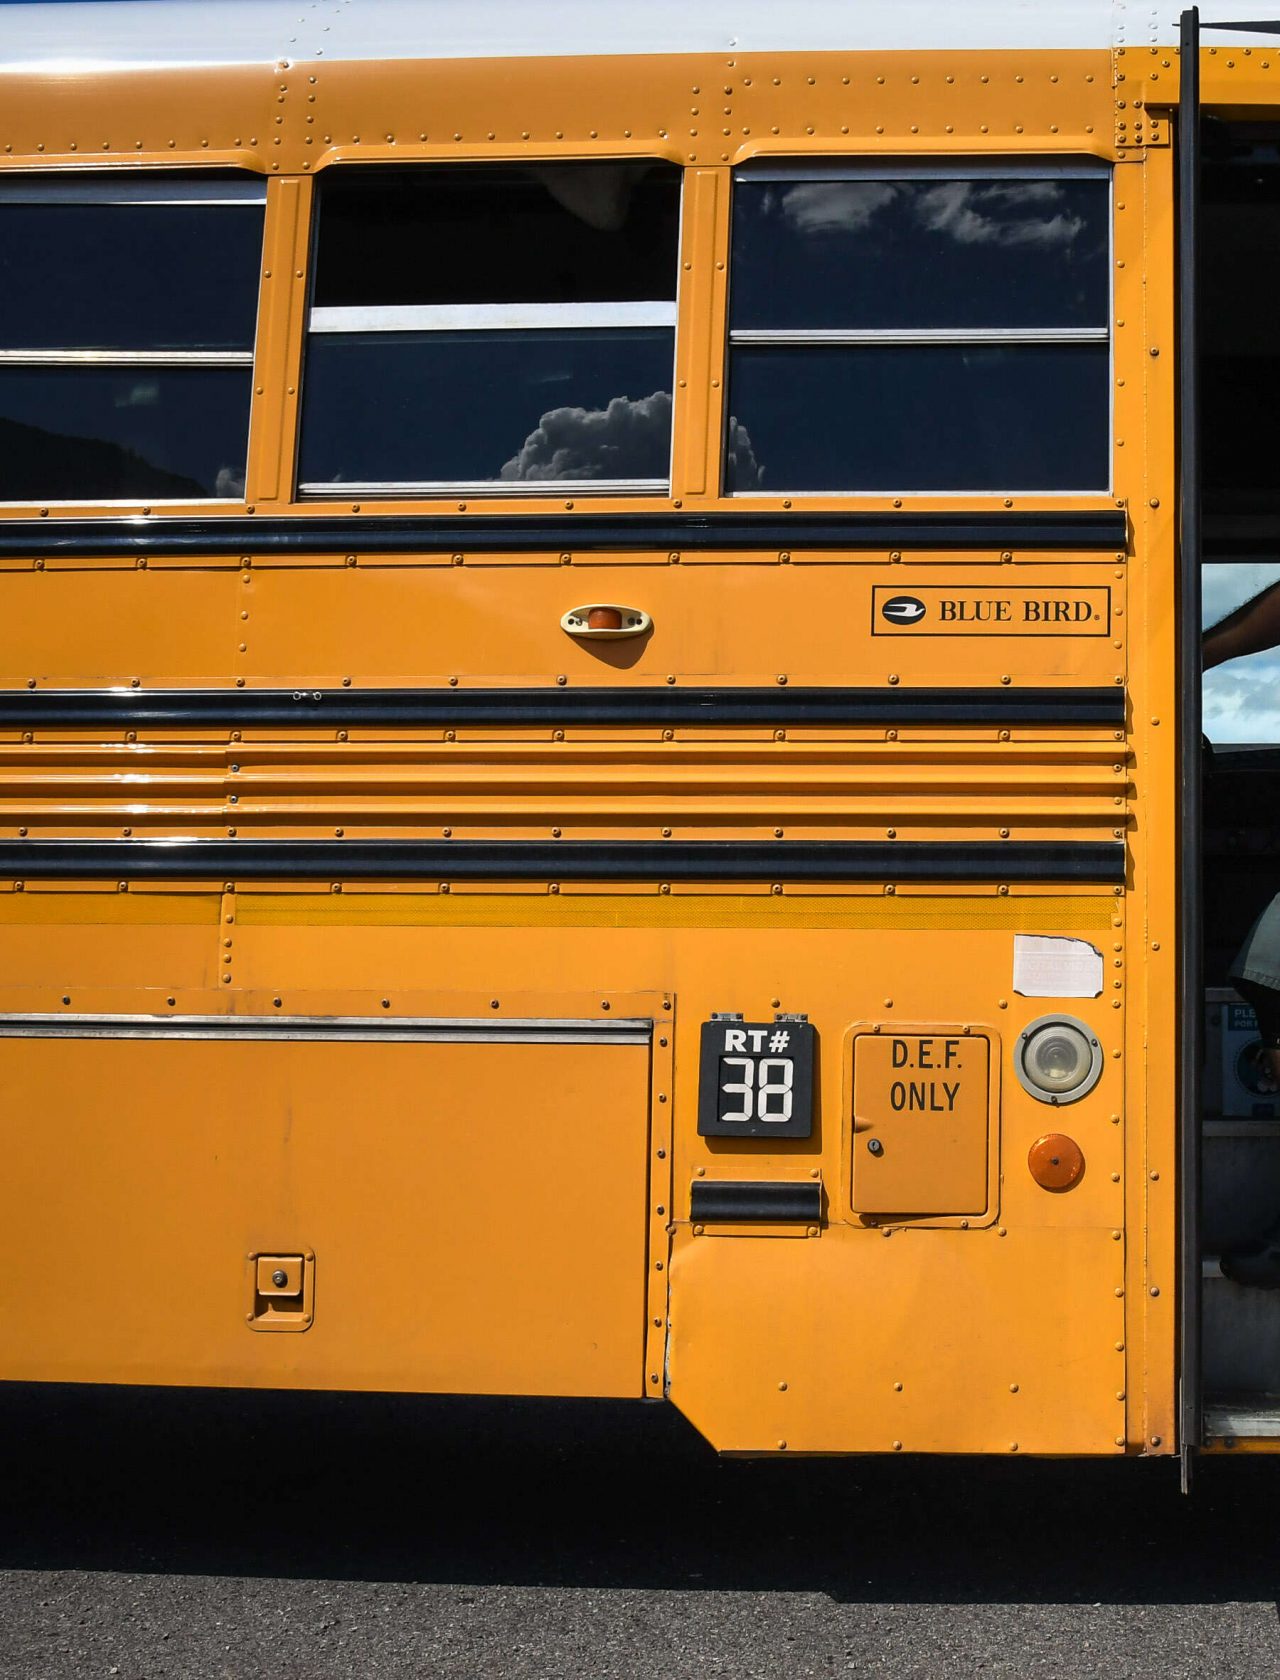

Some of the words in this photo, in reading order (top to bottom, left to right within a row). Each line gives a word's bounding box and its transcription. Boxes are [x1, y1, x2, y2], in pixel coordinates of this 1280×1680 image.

[939, 601, 1011, 621] BLUE
[725, 1030, 790, 1053] RT#
[892, 1040, 962, 1068] D.E.F.
[721, 1057, 794, 1122] 38
[890, 1082, 960, 1111] ONLY
